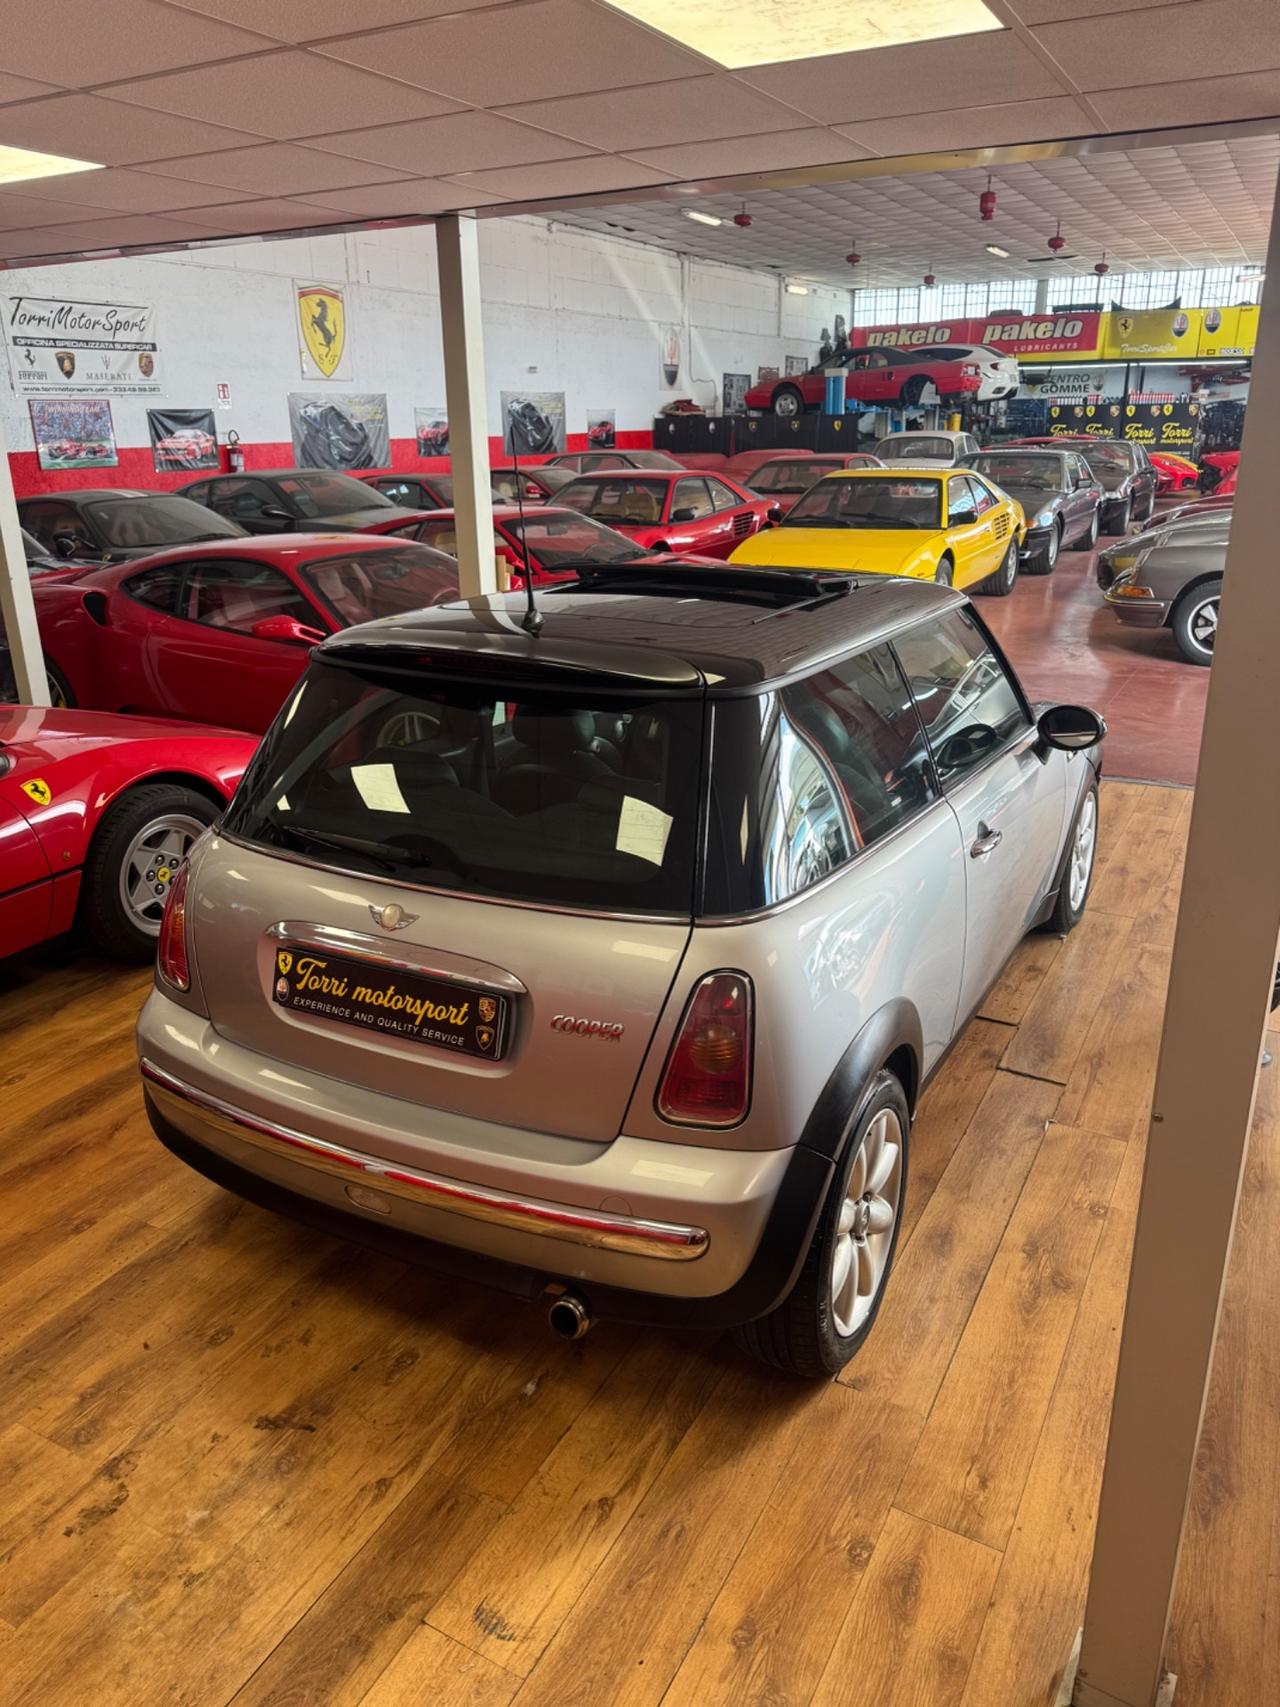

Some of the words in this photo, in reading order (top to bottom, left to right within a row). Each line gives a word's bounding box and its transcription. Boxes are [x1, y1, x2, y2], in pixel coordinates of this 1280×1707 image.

[982, 317, 1084, 345] pakelo
[16, 338, 55, 347] OFFICINA
[1013, 342, 1079, 352] LUBRICANTS
[1040, 383, 1090, 393] GOMME
[1124, 422, 1154, 439] Torri
[1161, 422, 1192, 439] Torri
[296, 957, 349, 998] Torri
[352, 985, 470, 1026] motorsport
[293, 996, 351, 1018] EXPERIENCE
[354, 1011, 375, 1025] AND
[377, 1016, 419, 1036] QUALITY
[422, 1028, 466, 1047] SERVICE
[550, 1014, 625, 1043] COOPER
